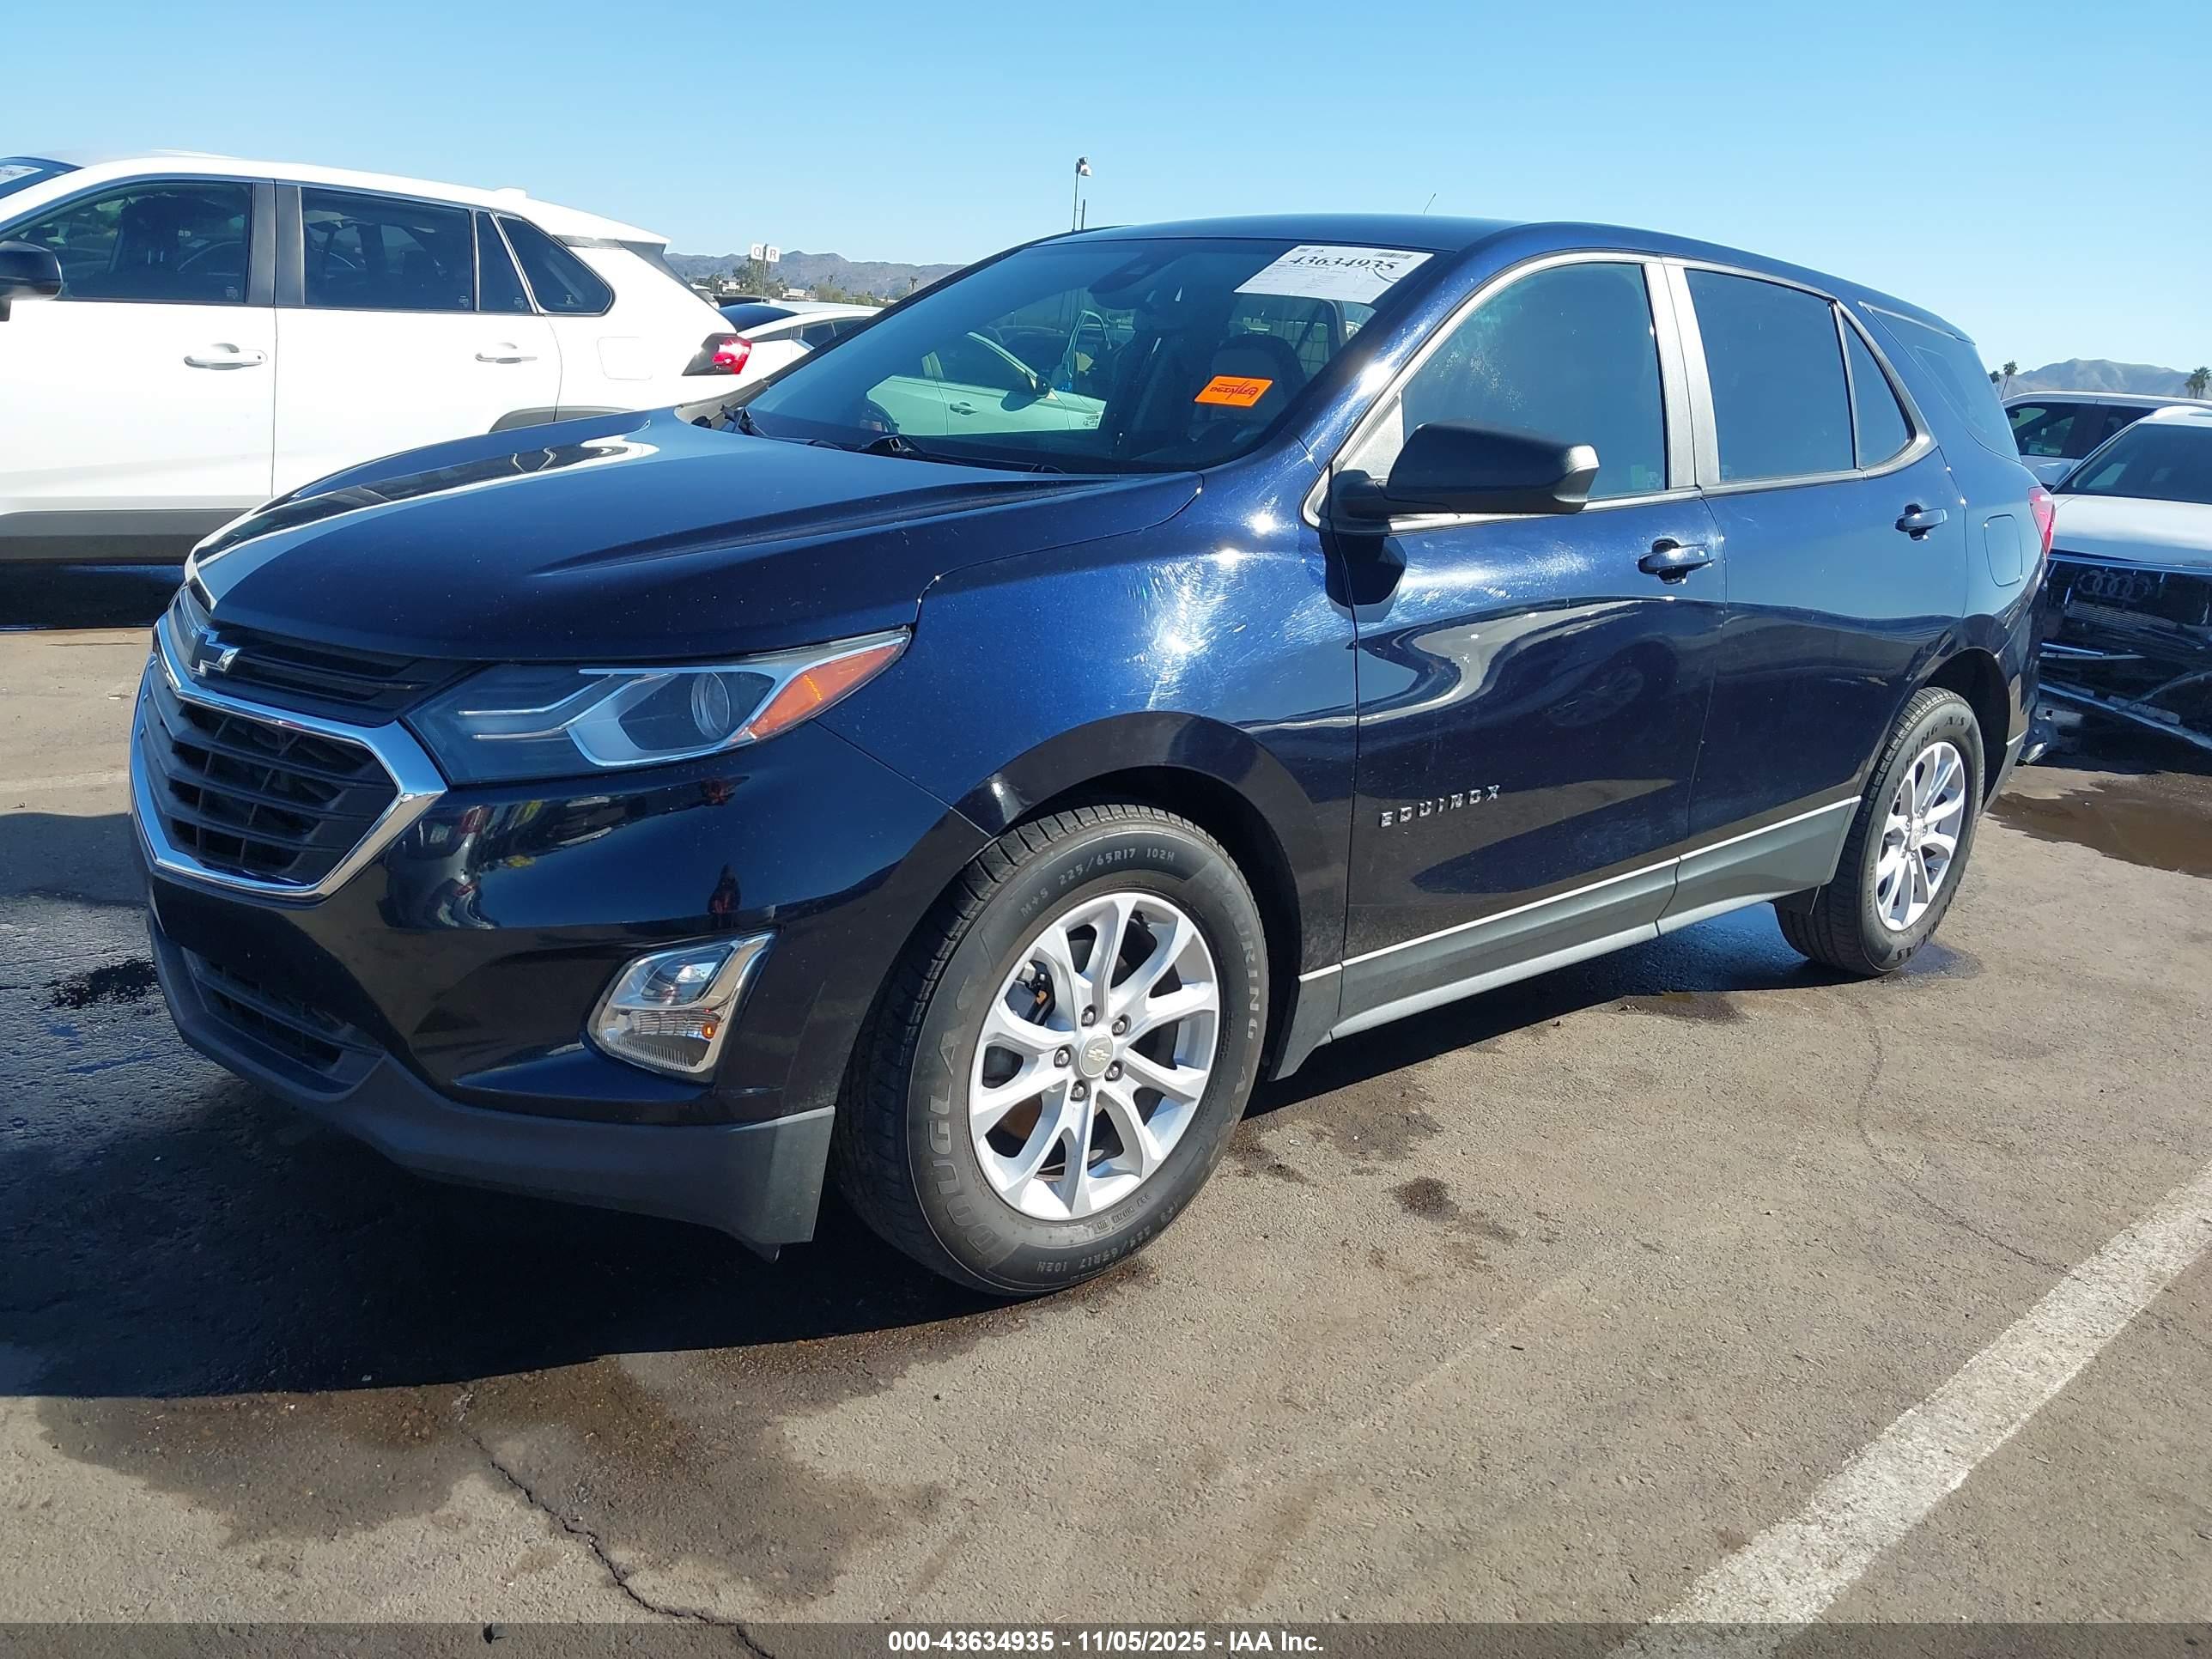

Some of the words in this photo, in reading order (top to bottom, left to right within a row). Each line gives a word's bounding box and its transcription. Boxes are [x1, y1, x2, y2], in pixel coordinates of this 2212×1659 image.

[753, 246, 763, 258] Q
[769, 248, 777, 260] R
[1289, 255, 1400, 271] 43634935
[1381, 784, 1501, 828] EQUINOX
[1058, 848, 1136, 886] 225/65R17
[1146, 847, 1176, 861] 102H
[1036, 1261, 1068, 1273] 102H
